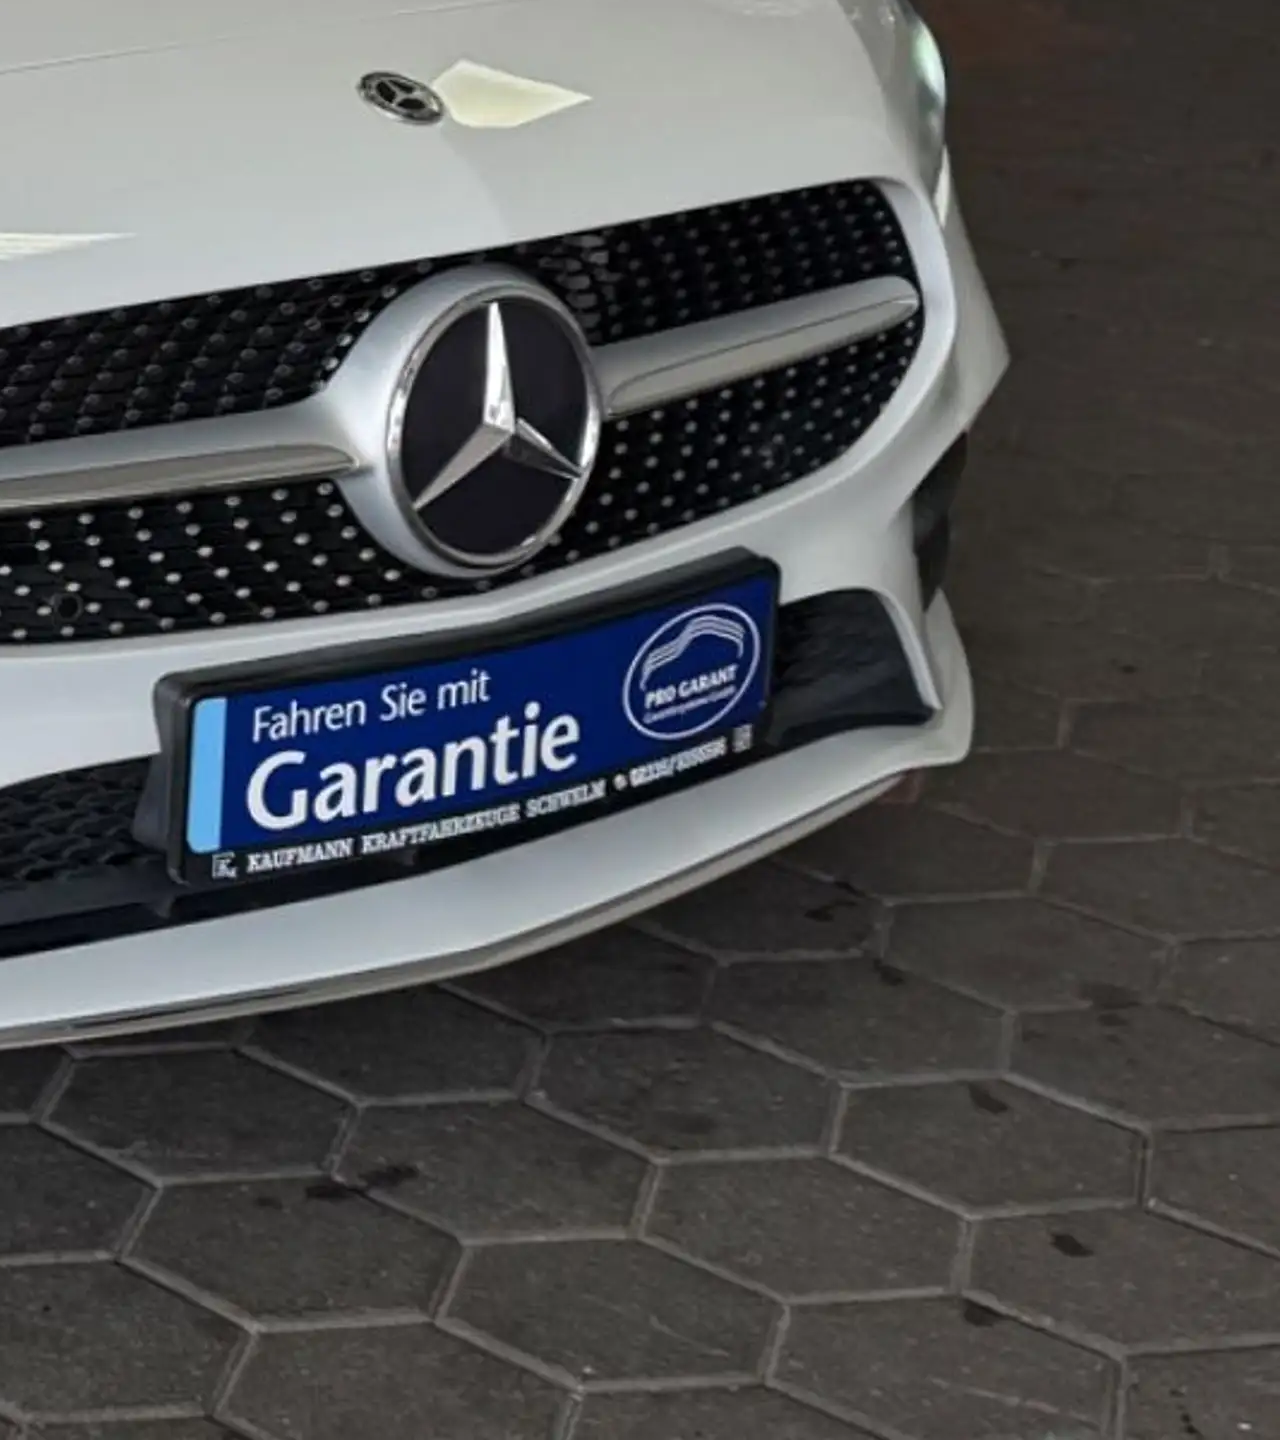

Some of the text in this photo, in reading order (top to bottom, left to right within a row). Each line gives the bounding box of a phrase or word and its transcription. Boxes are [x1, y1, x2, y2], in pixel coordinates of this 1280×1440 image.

[253, 667, 492, 744] Fahren Sie mit
[644, 684, 676, 709] PRO
[678, 663, 738, 697] GARANT
[246, 700, 581, 831] Garantie
[246, 838, 354, 874] KAUFMANN
